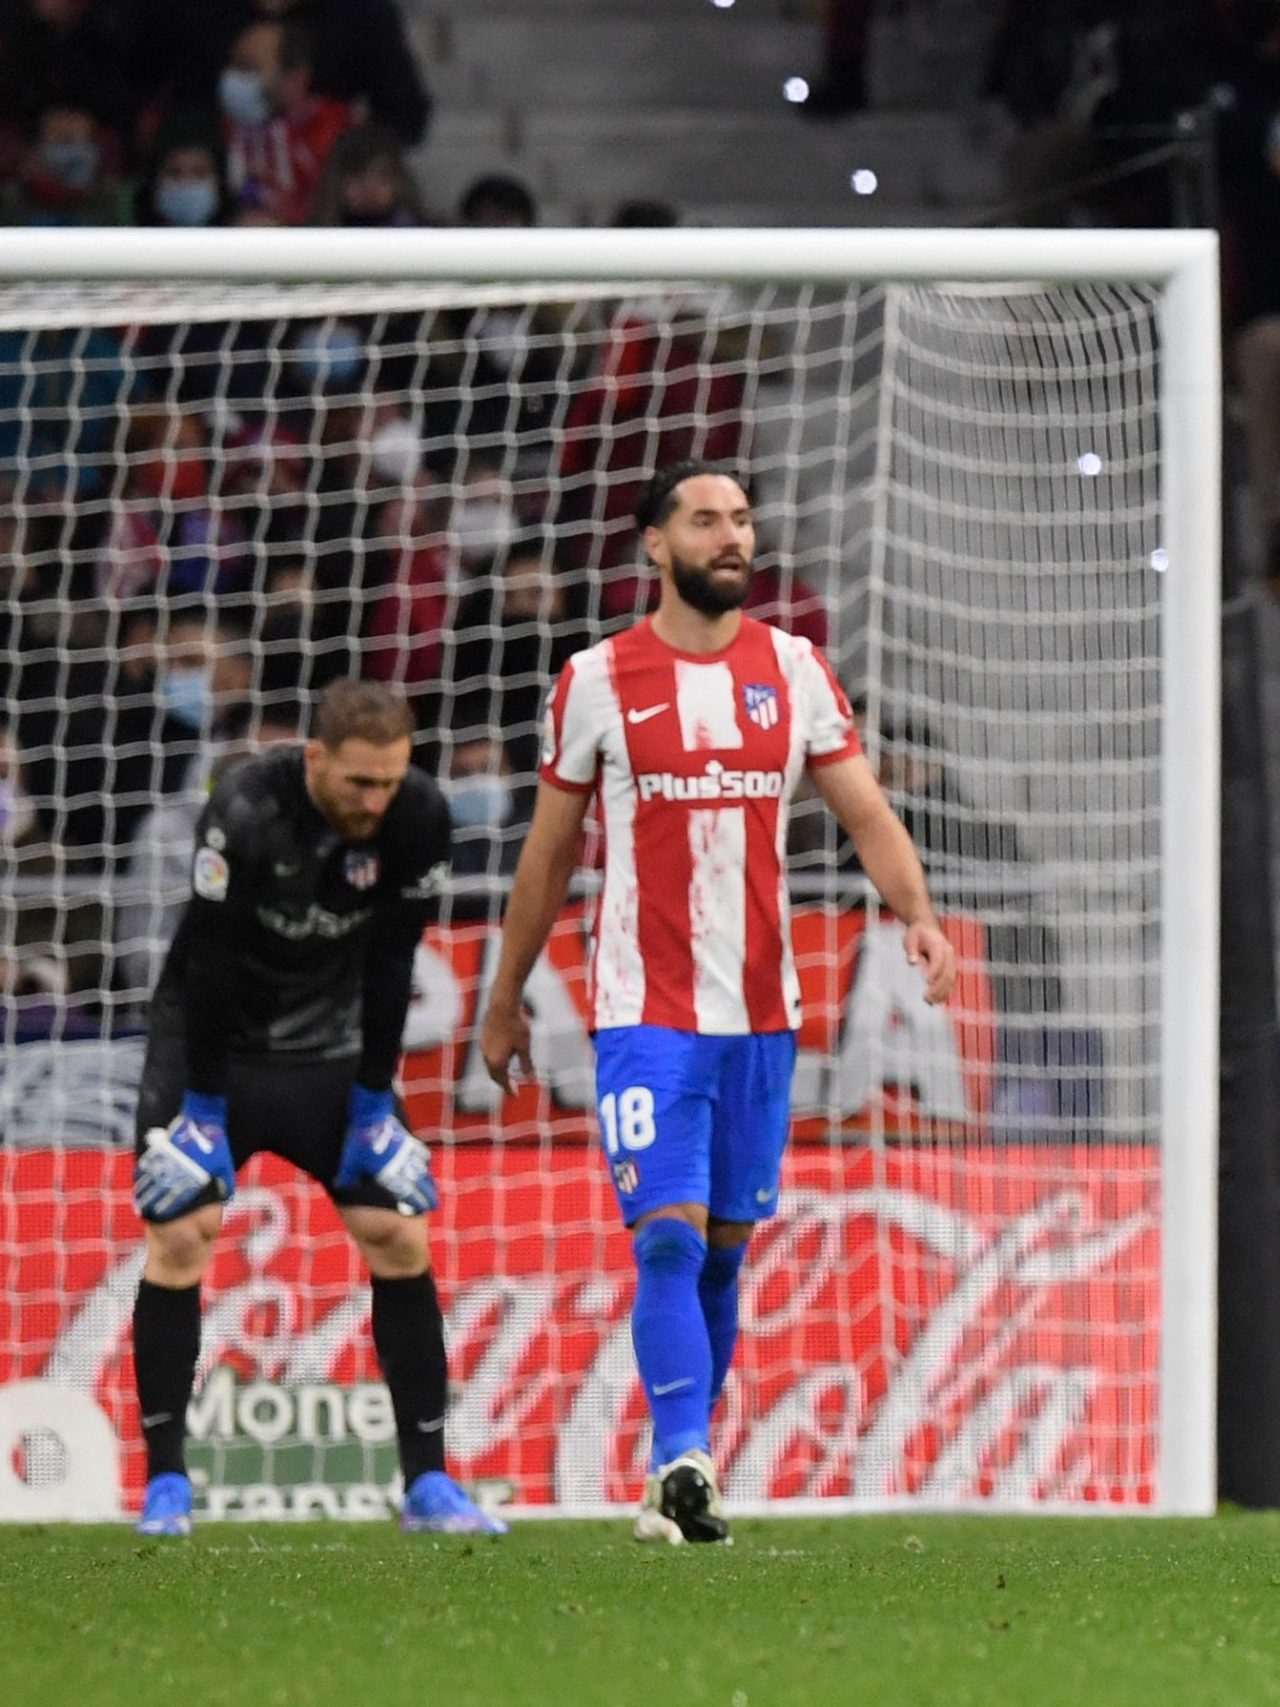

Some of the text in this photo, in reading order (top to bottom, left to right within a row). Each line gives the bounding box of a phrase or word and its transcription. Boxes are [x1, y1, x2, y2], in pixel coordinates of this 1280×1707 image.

[638, 760, 783, 801] Plus500
[600, 1086, 657, 1157] 18
[186, 1367, 462, 1442] Mone
